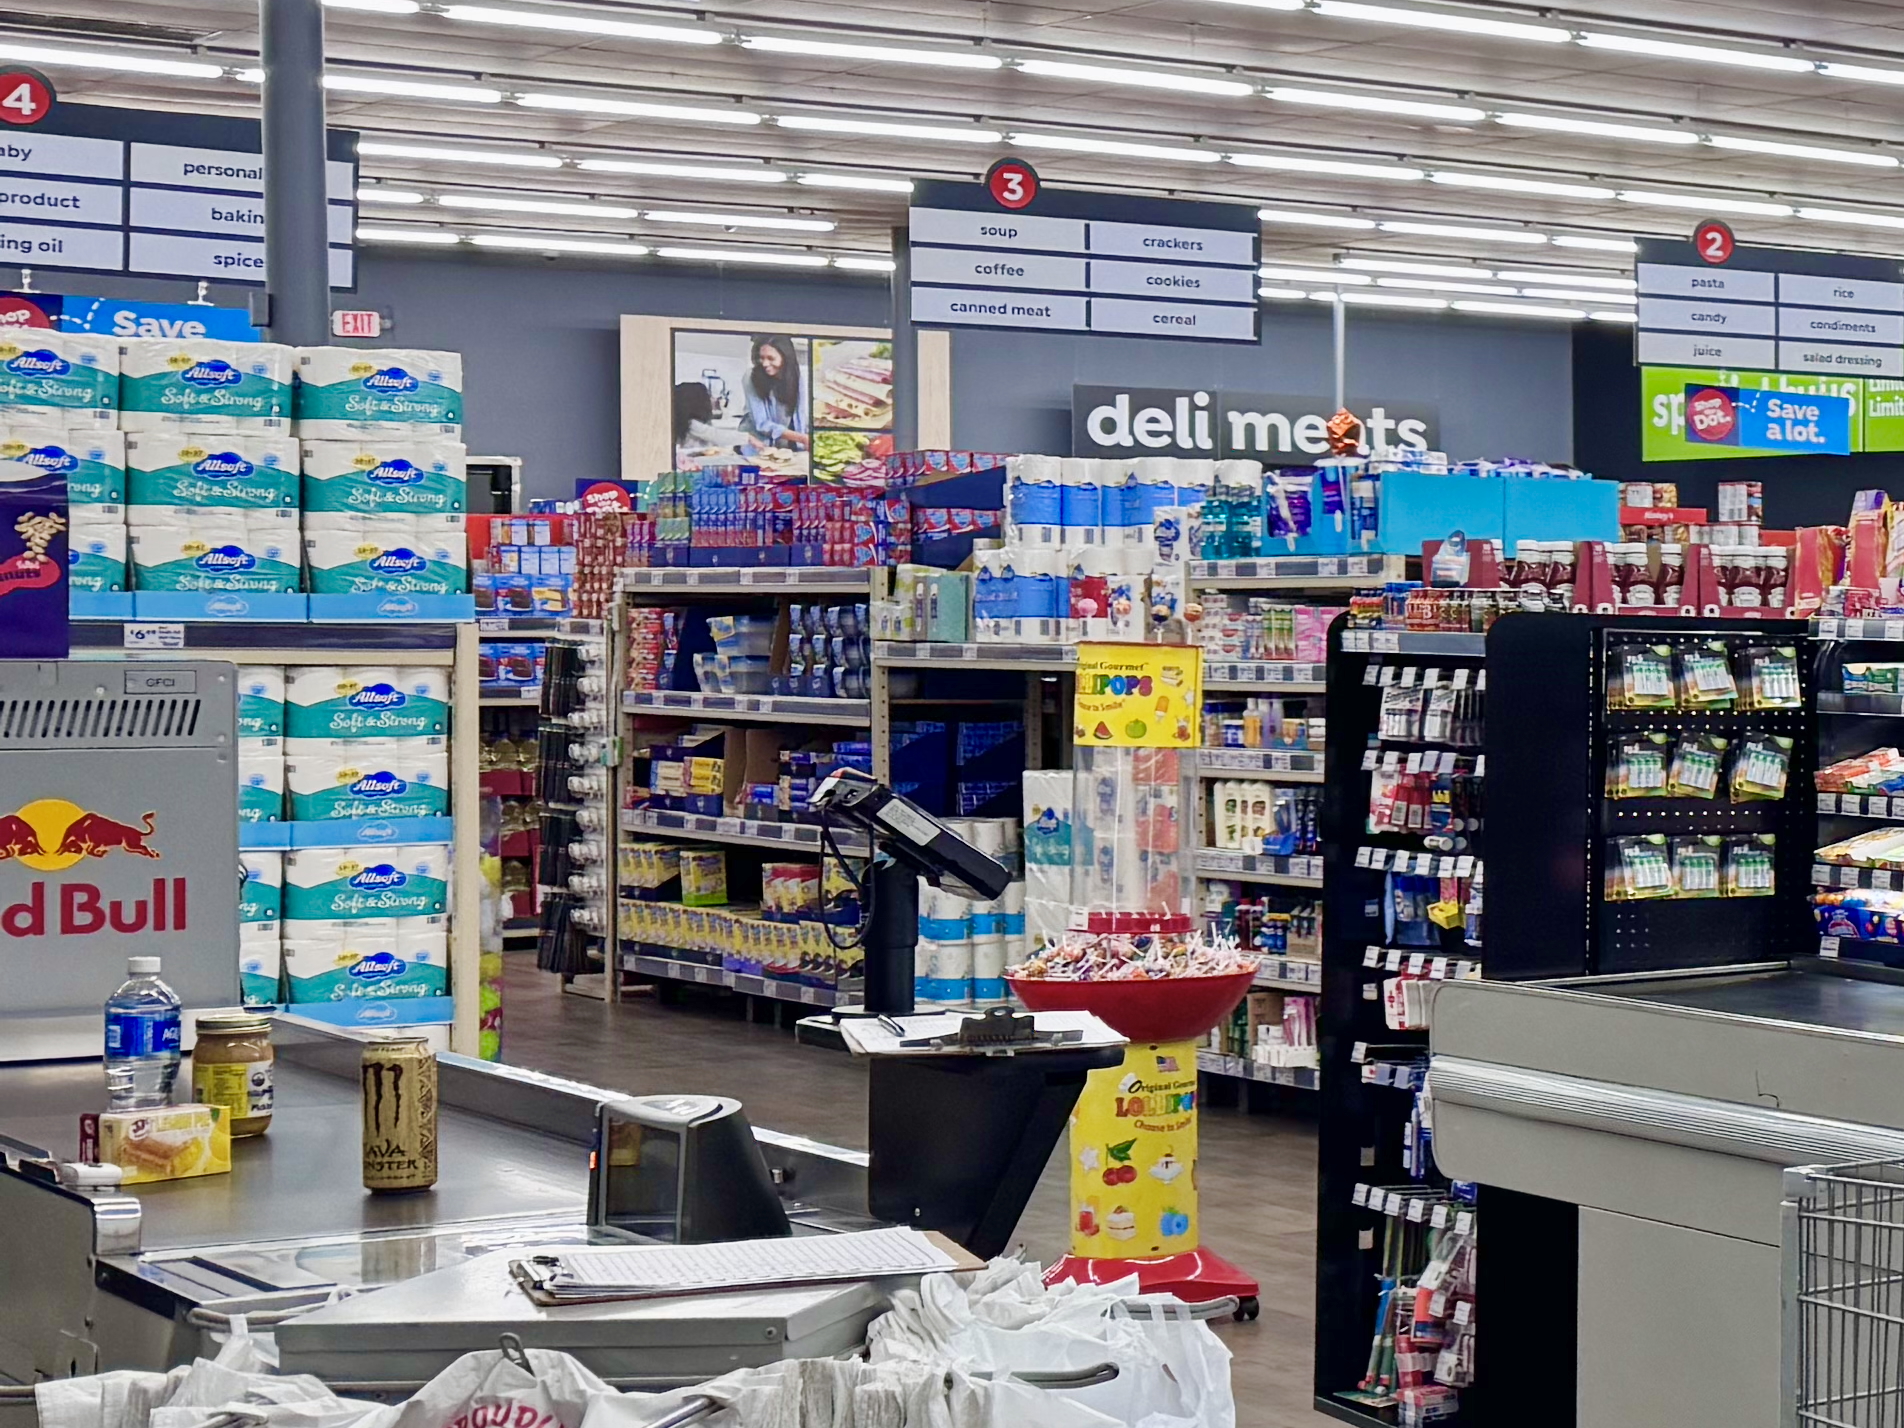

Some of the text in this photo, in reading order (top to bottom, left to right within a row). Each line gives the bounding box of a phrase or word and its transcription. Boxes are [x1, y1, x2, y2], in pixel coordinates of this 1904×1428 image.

[2, 83, 36, 114] 4
[0, 144, 31, 161] aby
[183, 162, 262, 180] personal
[1002, 172, 1024, 200] 3
[211, 207, 264, 224] bakin
[980, 225, 1018, 239] soup
[38, 237, 63, 252] oil
[1143, 236, 1203, 252] crackers
[1705, 232, 1724, 256] 2
[213, 252, 264, 269] spice
[975, 262, 1024, 277] coffee
[1146, 274, 1200, 289] cookies
[1691, 278, 1725, 289] pasta
[1833, 286, 1854, 298] rice
[950, 301, 1051, 317] canned meat
[114, 311, 206, 338] Save
[342, 313, 373, 334] EXIT
[1152, 313, 1196, 326] cereal
[1691, 312, 1727, 324] candy
[1810, 320, 1876, 333] condiments
[1693, 346, 1722, 357] juice
[1803, 352, 1882, 368] salad dressing
[11, 356, 64, 373] Allsoft
[185, 366, 235, 382] Allsoft
[367, 373, 414, 390] Allsoft
[1693, 399, 1722, 412] Shop
[1766, 399, 1820, 422] Save
[1086, 391, 1213, 450] deli
[1695, 412, 1732, 431] Dot.
[1766, 419, 1825, 443] a lot.
[197, 457, 247, 474] Allsoft
[200, 551, 250, 568] Allsoft
[1100, 662, 1144, 671] Gourmet
[353, 689, 400, 707] Allsoft
[353, 777, 402, 795] Allsoft
[354, 870, 401, 887] Allsoft
[60, 877, 187, 935] Bull
[351, 958, 400, 977] Allsoft
[1128, 1079, 1171, 1094] Original
[1115, 1091, 1196, 1118] LOLLIPO
